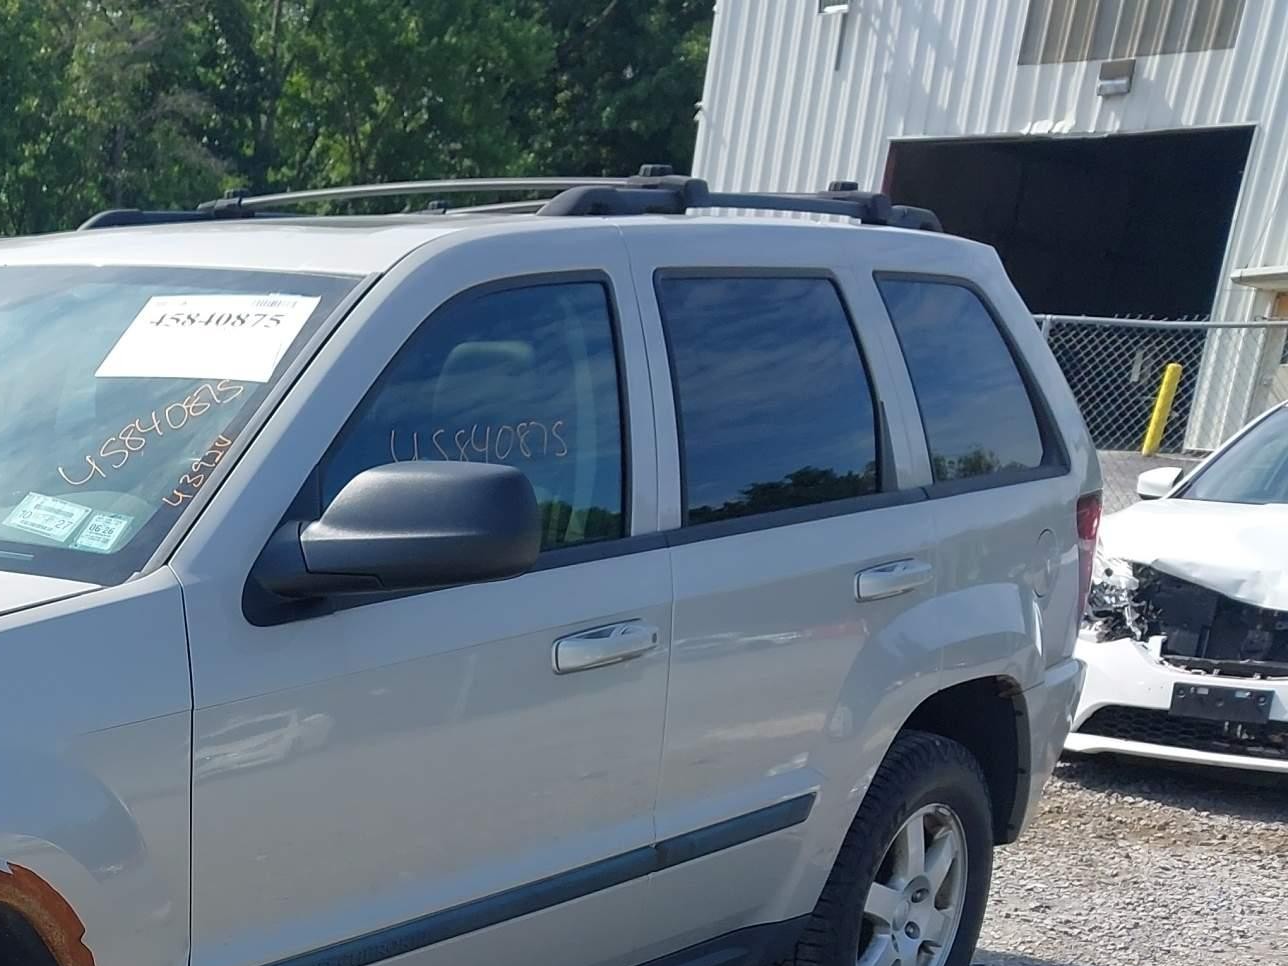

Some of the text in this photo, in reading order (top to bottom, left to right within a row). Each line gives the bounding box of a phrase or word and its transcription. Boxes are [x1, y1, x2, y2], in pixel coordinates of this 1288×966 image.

[149, 312, 289, 329] 45840875
[57, 379, 244, 485] 45840875
[390, 421, 568, 463] 45840875
